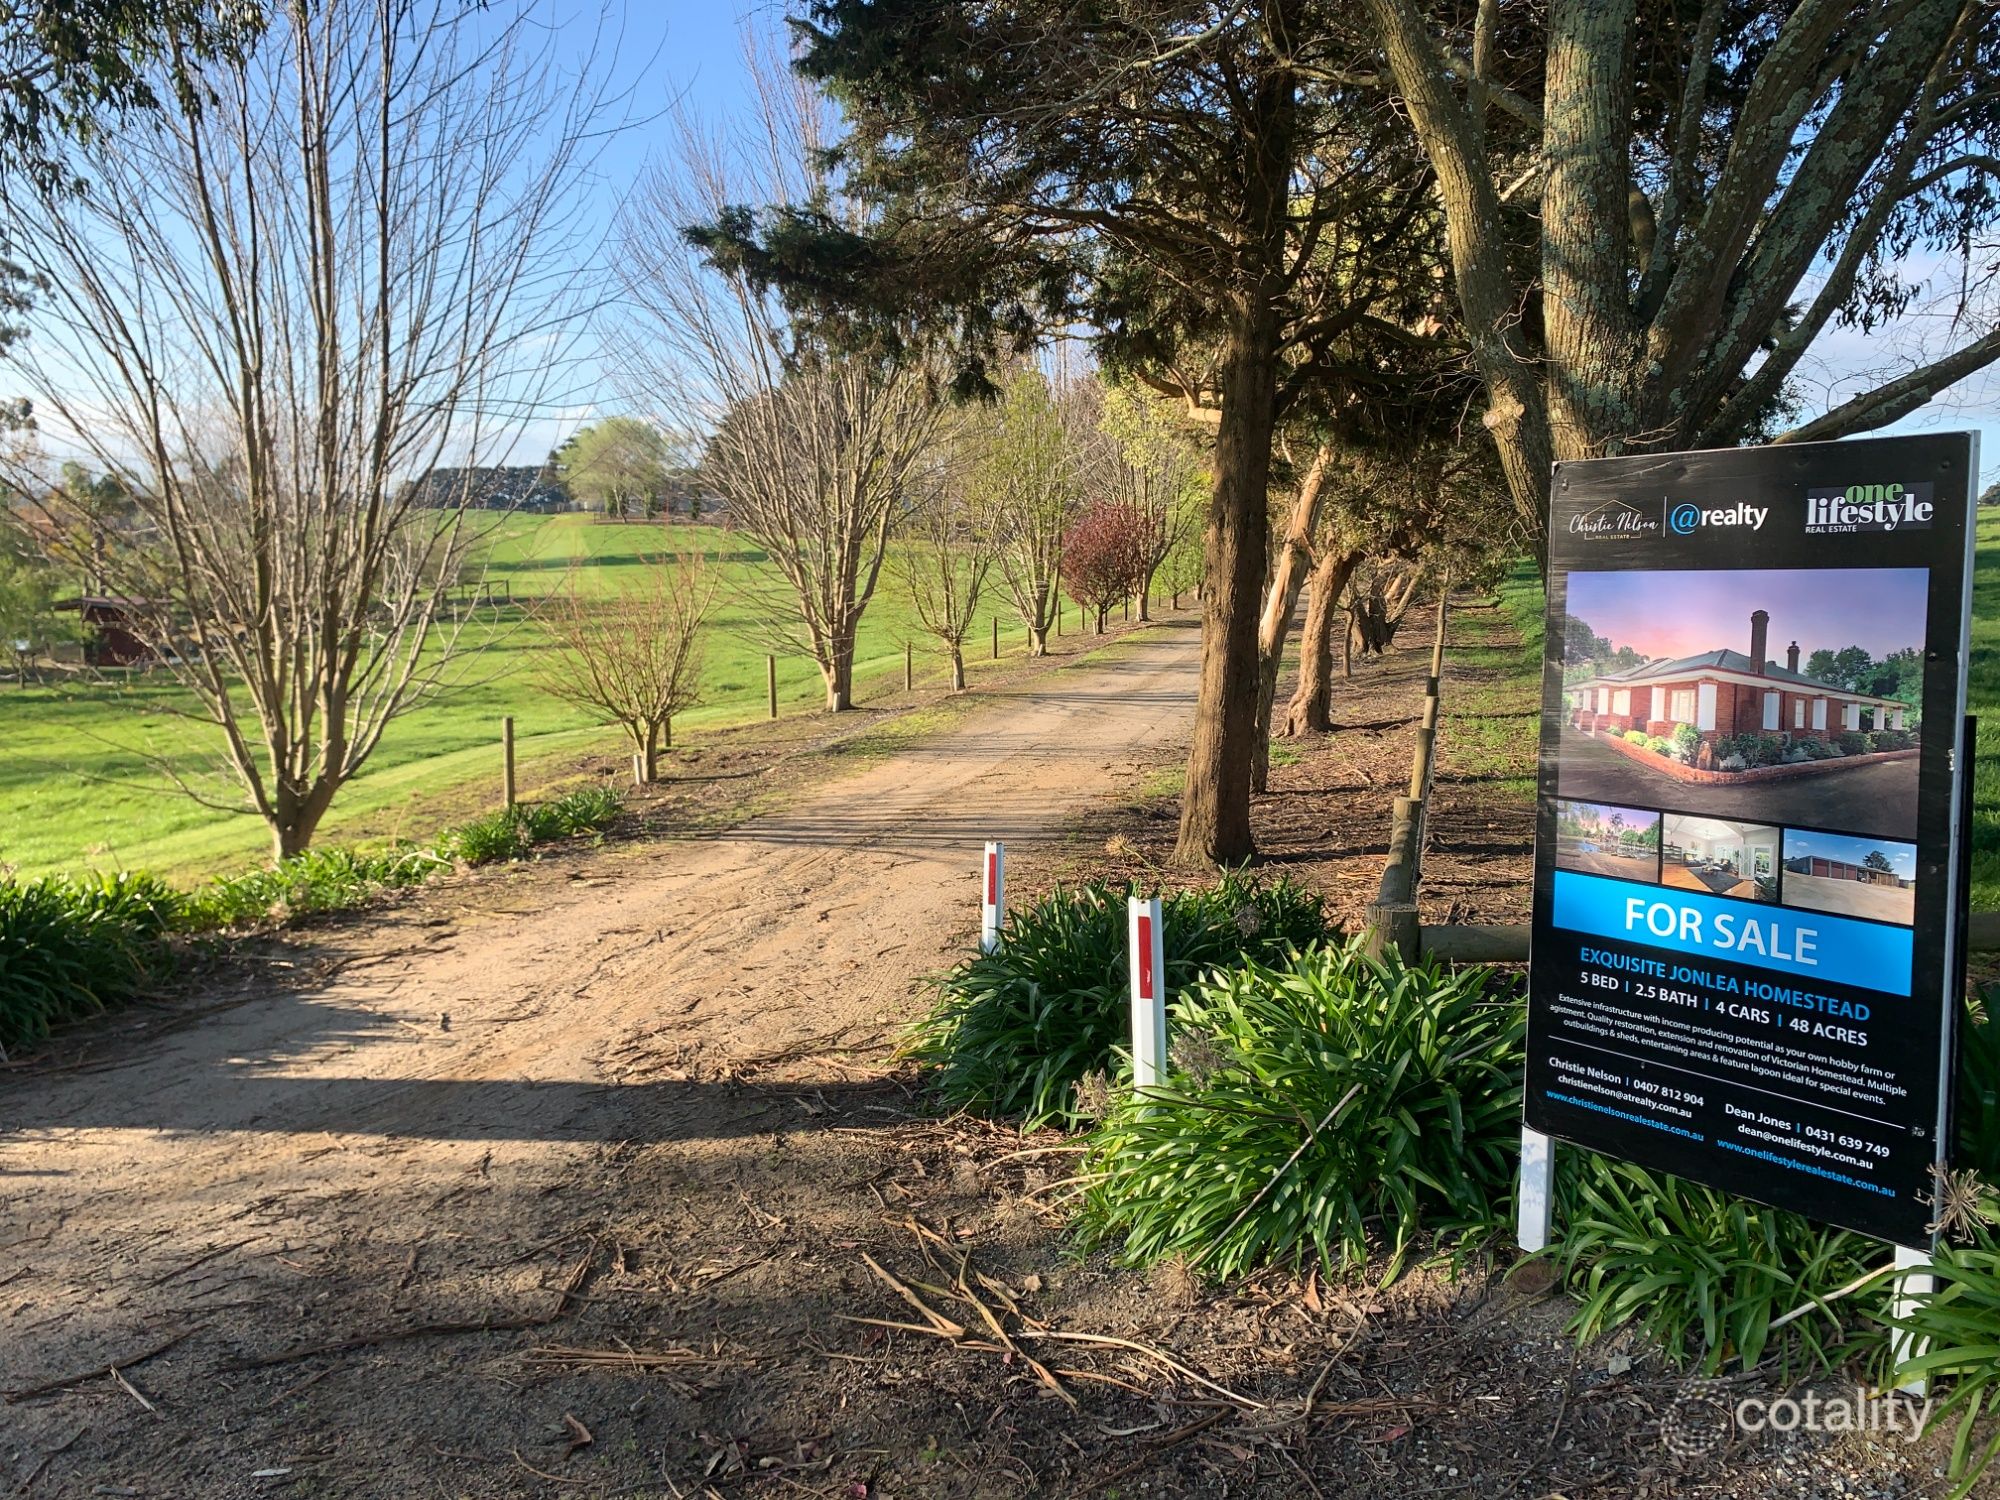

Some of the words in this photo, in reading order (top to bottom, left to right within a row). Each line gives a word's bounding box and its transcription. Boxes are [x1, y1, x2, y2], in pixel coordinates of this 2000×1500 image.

[1670, 502, 1768, 535] @realty
[1806, 493, 1933, 531] lifestyle
[1845, 483, 1904, 504] one
[1569, 513, 1615, 534] Christie
[1616, 511, 1659, 532] Nelson
[1805, 525, 1826, 534] REAL
[1828, 524, 1857, 533] ESTATE
[1625, 896, 1702, 944] FOR
[1713, 914, 1818, 966] SALE
[1580, 946, 1666, 979] EXQUISITE
[1669, 964, 1739, 995] JONLEA
[1744, 980, 1871, 1022] HOMESTEAD
[1580, 971, 1589, 985] 5
[1590, 973, 1619, 991] BED
[1635, 983, 1656, 1000] 2.5
[1659, 988, 1698, 1009] BATH
[1715, 1001, 1726, 1014] 4
[1728, 1004, 1770, 1025] CARS
[1789, 1017, 1810, 1033] 48
[1813, 1021, 1868, 1047] ACRES
[1549, 1003, 1586, 1019] agistment.
[1587, 1011, 1614, 1026] Quality
[1614, 1019, 1657, 1037] restoration,
[1658, 1029, 1696, 1045] extension
[1697, 1037, 1713, 1049] and
[1714, 1042, 1759, 1060] renovation
[1761, 1053, 1771, 1063] of
[1771, 1054, 1810, 1073] Victorian
[1811, 1065, 1866, 1087] Homestead.
[1867, 1080, 1908, 1097] Multiple
[1559, 993, 1592, 1008] Extensive
[1593, 1001, 1642, 1020] infrastructure
[1643, 1013, 1660, 1024] with
[1661, 1017, 1691, 1031] income
[1692, 1025, 1734, 1043] producing
[1735, 1034, 1774, 1051] potential
[1775, 1044, 1785, 1053] as
[1785, 1047, 1806, 1059] your
[1807, 1053, 1828, 1064] own
[1829, 1055, 1860, 1073] hobby
[1861, 1063, 1883, 1078] farm
[1884, 1071, 1896, 1080] or
[1563, 1017, 1609, 1037] outbuildings
[1609, 1029, 1616, 1037] &
[1616, 1031, 1640, 1044] sheds,
[1641, 1037, 1688, 1057] entertaining
[1689, 1049, 1711, 1061] areas
[1711, 1054, 1719, 1062] &
[1720, 1055, 1750, 1071] feature
[1751, 1063, 1781, 1080] lagoon
[1782, 1071, 1804, 1084] ideal
[1805, 1076, 1819, 1087] for
[1819, 1080, 1851, 1097] special
[1852, 1092, 1886, 1105] events.
[1549, 1056, 1586, 1075] Christie
[1587, 1066, 1621, 1085] Nelson
[1633, 1079, 1659, 1096] 0407
[1661, 1086, 1682, 1101] 812
[1683, 1092, 1705, 1107] 904
[1557, 1074, 1692, 1119] christienelson@atrealty.com.au
[1546, 1089, 1704, 1142] www.christienelsonrealestate.com.au
[1725, 1103, 1755, 1121] Dean
[1756, 1112, 1792, 1131] Jones
[1805, 1125, 1835, 1143] 0431
[1838, 1135, 1863, 1150] 639
[1865, 1141, 1890, 1158] 749
[1717, 1138, 1896, 1198] www.onelifestylerealestate.com.au
[1737, 1123, 1873, 1170] dean@onelifestyle.com.au
